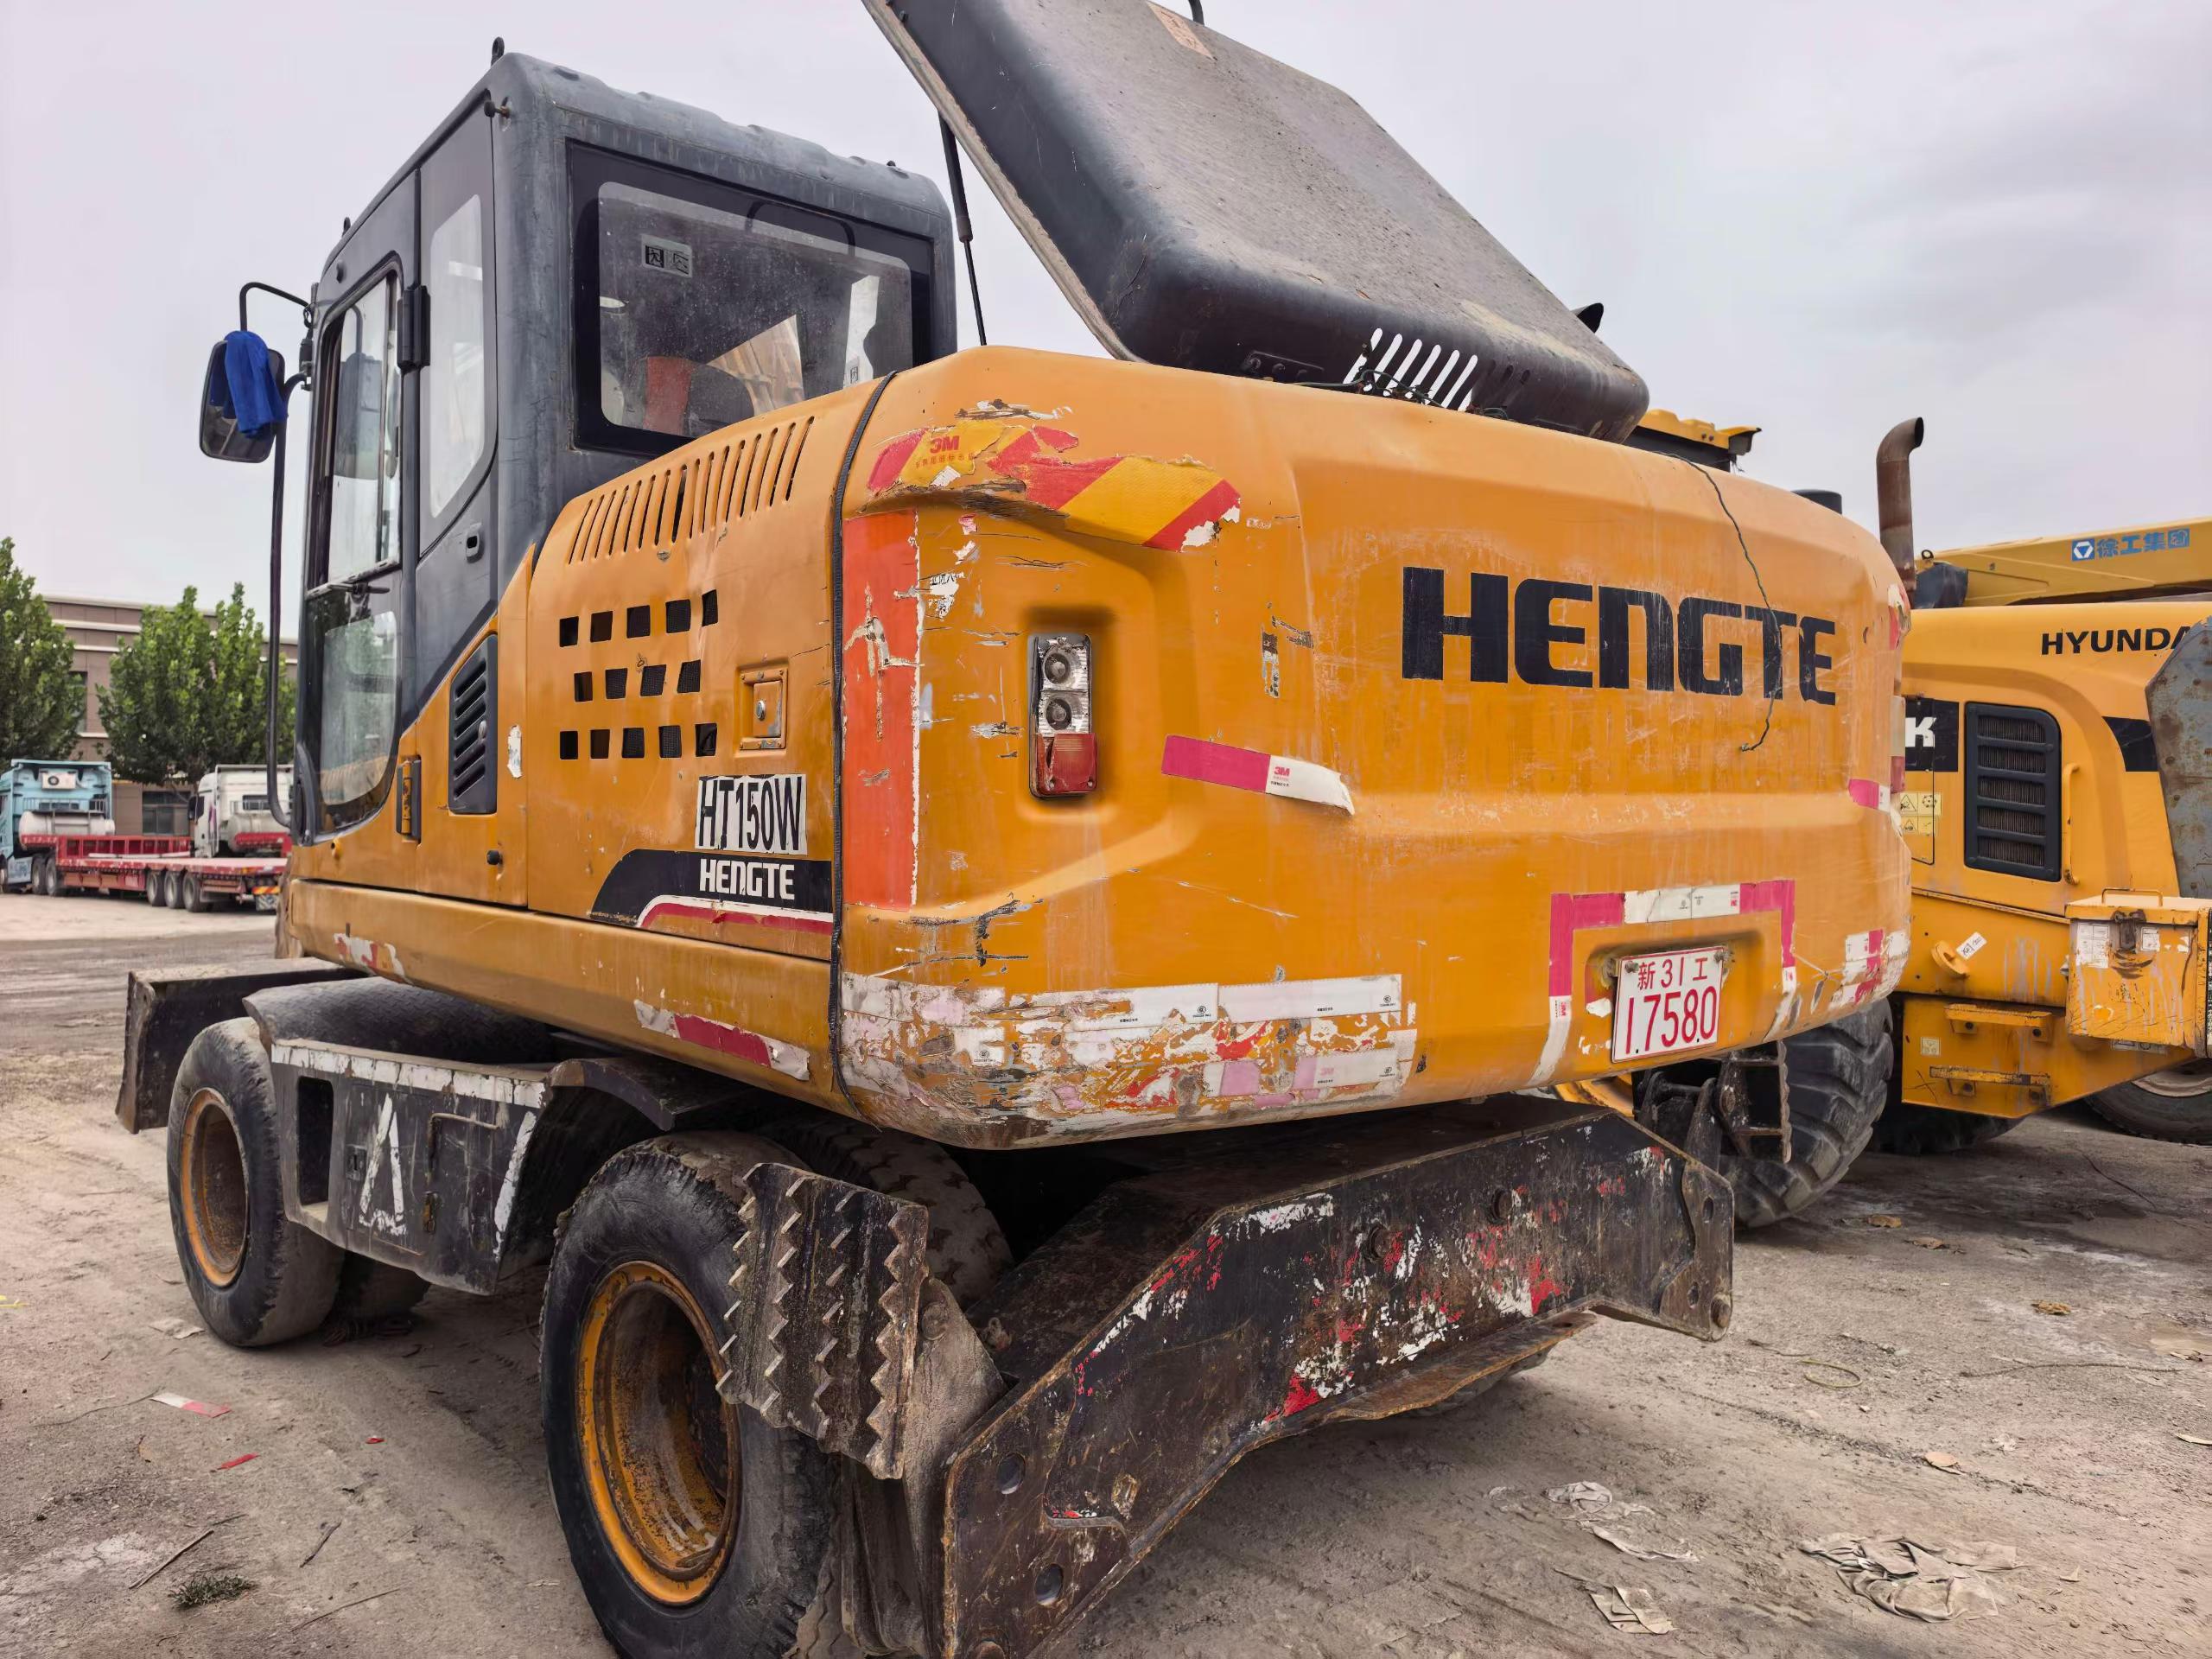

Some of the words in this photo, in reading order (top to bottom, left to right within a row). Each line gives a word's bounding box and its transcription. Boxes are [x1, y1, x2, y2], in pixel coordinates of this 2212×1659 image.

[2096, 528, 2190, 559] 徐工集团
[1402, 566, 1836, 706] HENGTE
[2042, 626, 2191, 656] HYUNDA
[1274, 766, 1290, 776] 3M
[698, 776, 803, 851] HT150W
[699, 858, 795, 900] HENGTE
[1625, 986, 1717, 1054] 17580
